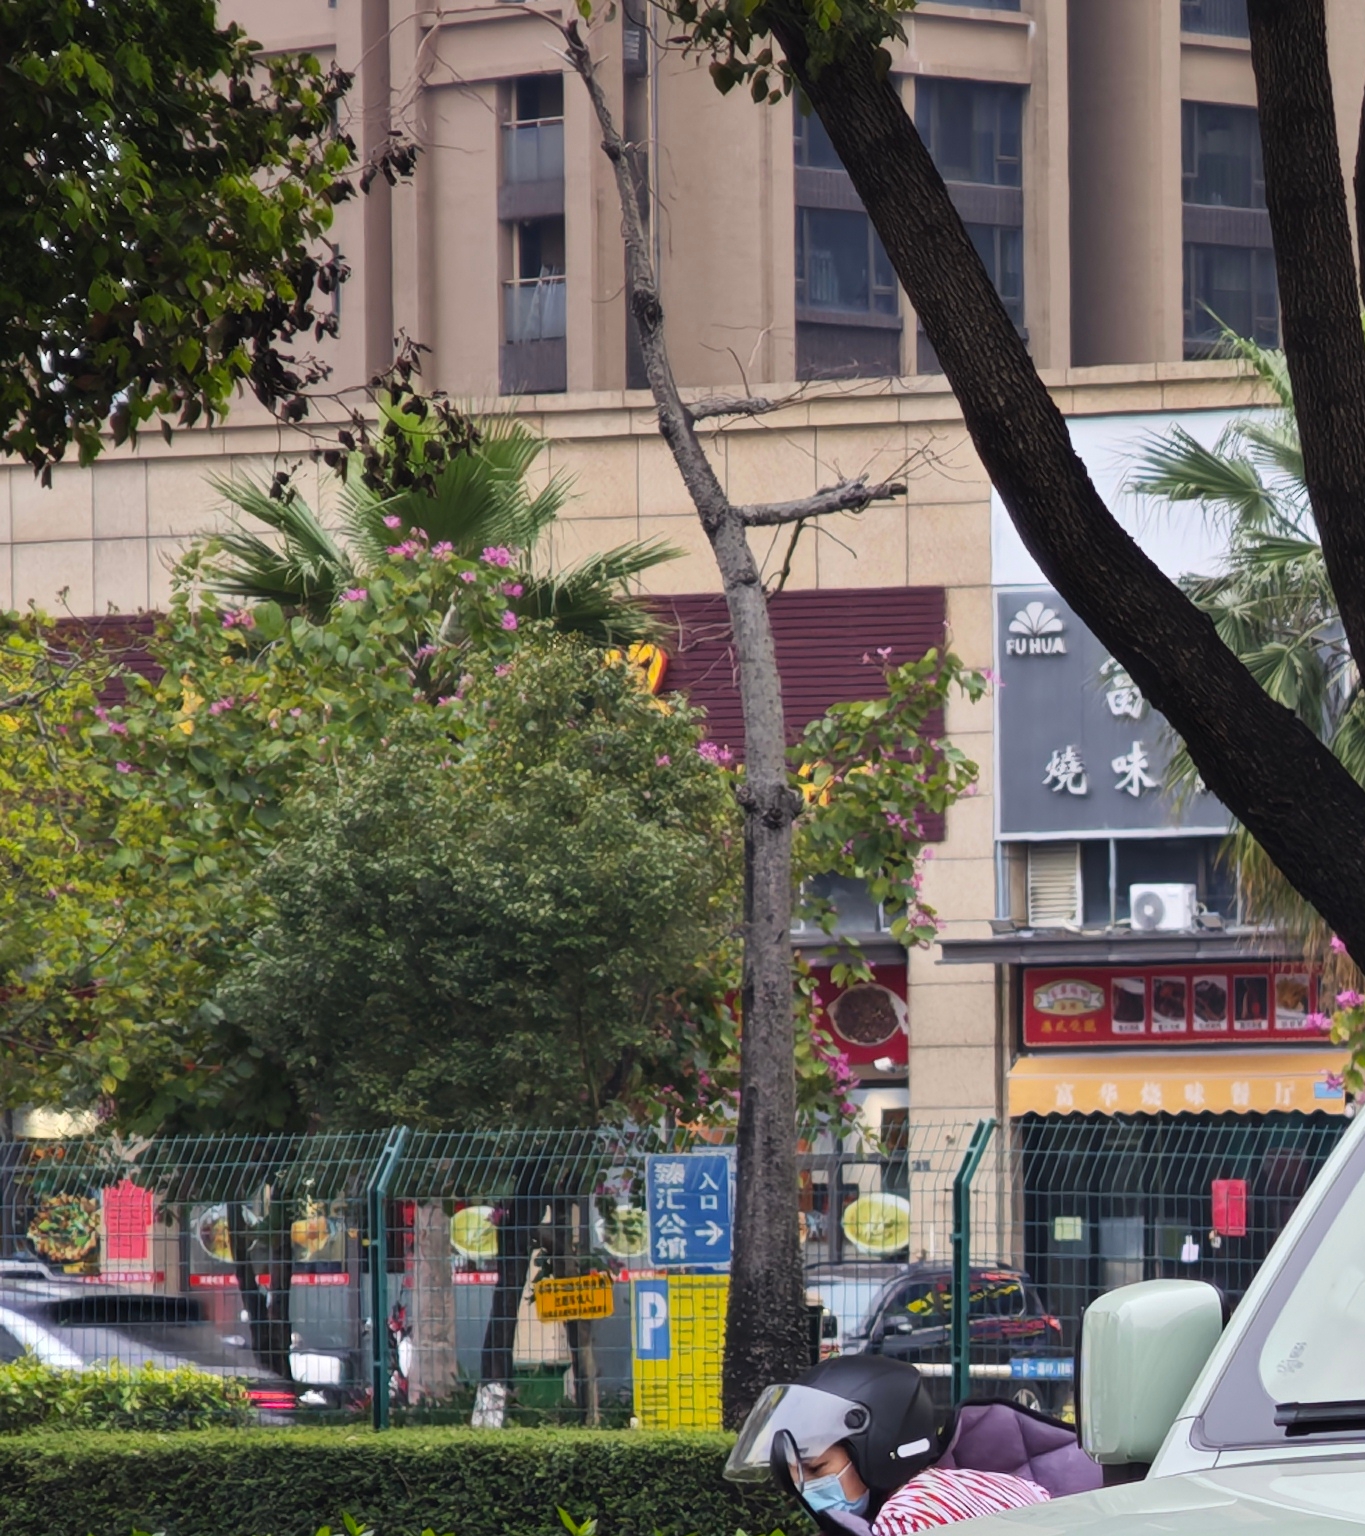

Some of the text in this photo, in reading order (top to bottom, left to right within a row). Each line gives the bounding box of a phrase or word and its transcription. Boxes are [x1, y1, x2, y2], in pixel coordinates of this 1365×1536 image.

[1006, 637, 1067, 656] FU HUA
[654, 1162, 687, 1260] 臻汇公馆
[699, 1171, 720, 1210] 入口
[638, 1291, 667, 1350] P
